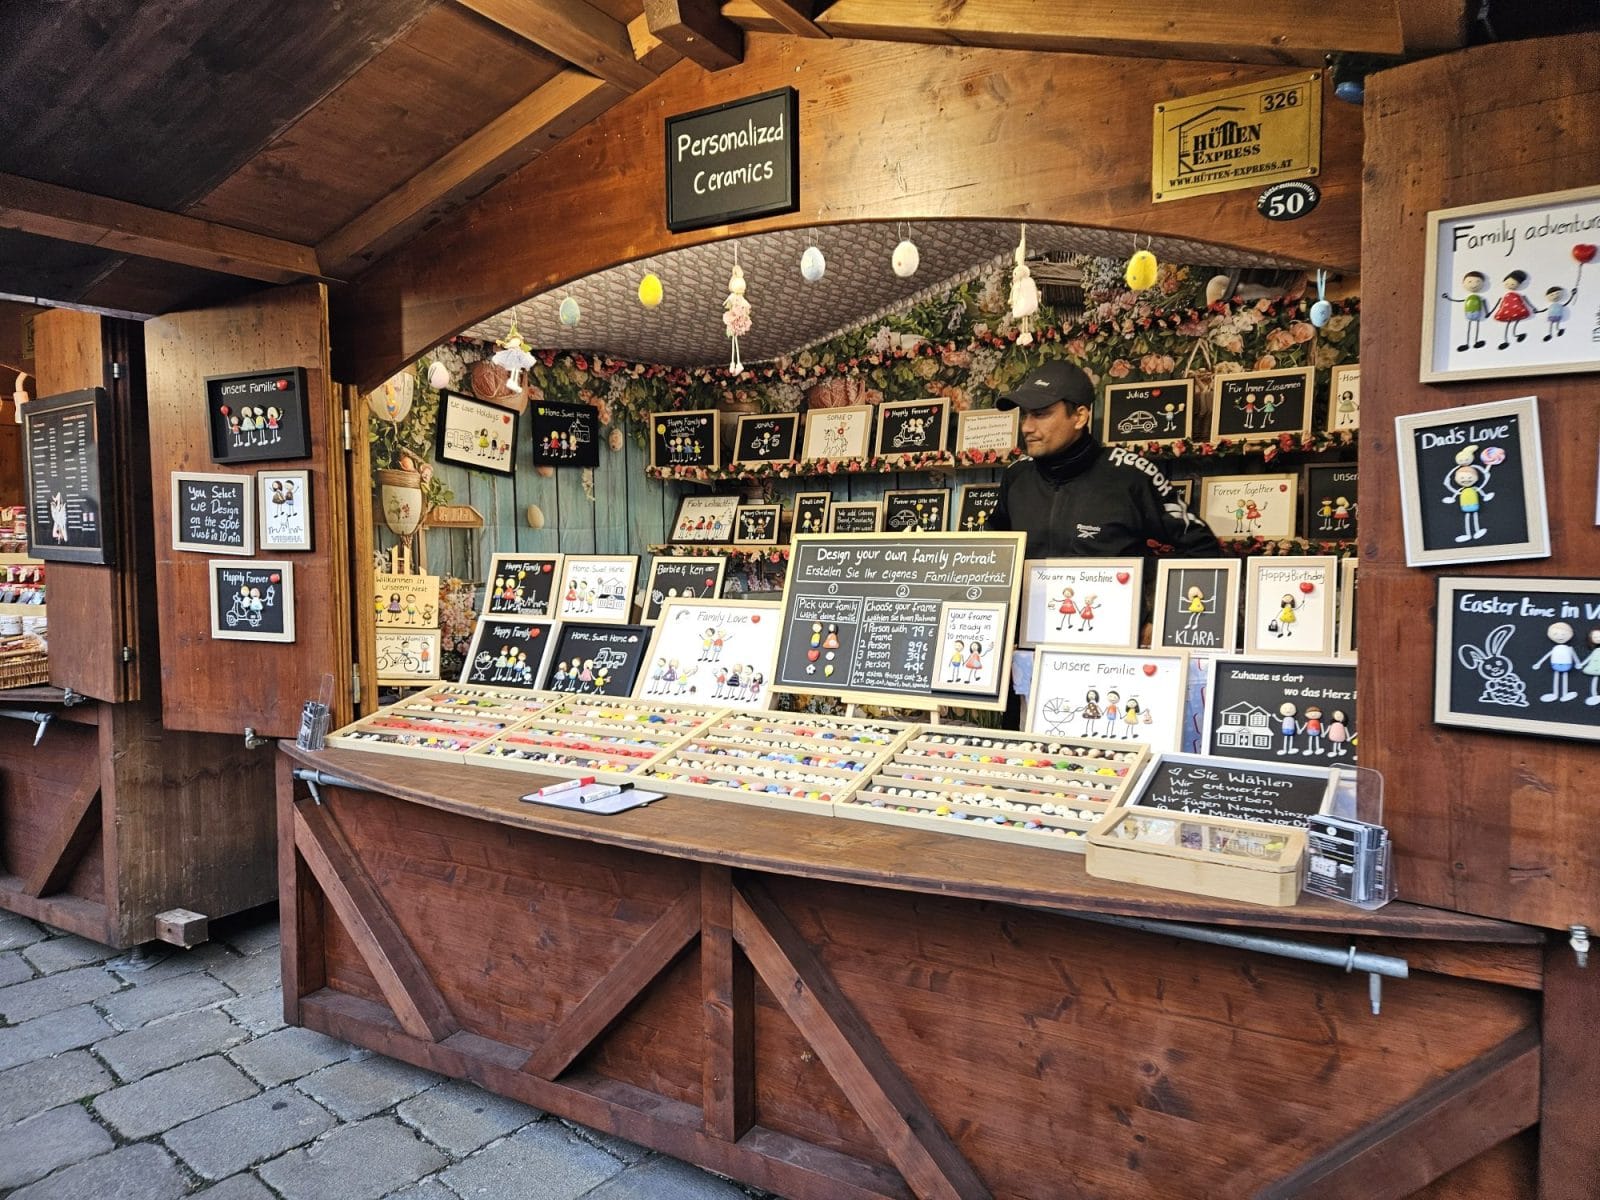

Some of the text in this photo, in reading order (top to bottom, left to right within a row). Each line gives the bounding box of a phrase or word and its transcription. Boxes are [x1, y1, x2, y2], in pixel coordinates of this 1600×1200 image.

[1264, 91, 1297, 111] 326
[677, 113, 784, 162] Personalized
[1193, 121, 1262, 151] HÜTTEN
[1193, 144, 1261, 165] EXPRESS
[694, 161, 773, 194] Ceramics
[1169, 159, 1293, 187] WWW.HÜTTEN-EXPRESS.AT
[1269, 193, 1304, 216] 50
[1452, 219, 1516, 257] Family
[249, 381, 277, 393] Familie
[461, 403, 474, 412] Love
[1108, 447, 1173, 496] Reebok
[188, 485, 237, 500] You Select
[1213, 482, 1274, 497] Forever Together
[211, 499, 239, 520] Design
[190, 516, 240, 534] on the spot
[190, 526, 210, 539] Just
[219, 530, 227, 542] 10
[817, 548, 850, 565] Design
[855, 550, 880, 566] your
[884, 550, 907, 562] own
[912, 548, 949, 570] family
[505, 562, 541, 575] Happy Family
[572, 565, 589, 573] Home
[657, 564, 680, 575] Barbie
[689, 564, 704, 575] Ken
[805, 565, 1006, 586] Erstellen Sie Ihr eigenes Familienporträt
[1261, 568, 1291, 582] Happy
[223, 571, 268, 586] Happily Forever
[1037, 570, 1051, 580] You
[1066, 575, 1076, 584] my
[1080, 571, 1113, 583] Sunshine
[799, 598, 858, 616] Pick your family
[866, 601, 937, 615] Choose your frame
[1459, 593, 1579, 618] Easter time in
[697, 611, 749, 627] Family Love
[968, 612, 992, 621] frame
[493, 626, 532, 641] Happy Family
[868, 623, 890, 633] Person
[891, 624, 908, 634] with
[947, 632, 954, 640] 10
[960, 624, 981, 634] ready
[609, 634, 627, 642] Home
[860, 639, 866, 649] 2
[868, 641, 891, 650] Person
[870, 633, 893, 641] Frame
[858, 650, 864, 659] 3
[867, 651, 891, 660] Person
[865, 661, 891, 670] Person
[1097, 663, 1135, 676] Familie
[1231, 670, 1270, 681] Zuhause
[1282, 673, 1304, 683] dort
[1283, 687, 1351, 700] wo das Herz
[1188, 768, 1293, 788] Sie Wählen
[1170, 777, 1280, 797] Wir entwerfen
[1170, 787, 1194, 796] Wir
[1152, 794, 1180, 803] Wir
[1182, 797, 1221, 809] fügen
[1227, 803, 1273, 815] Namen
